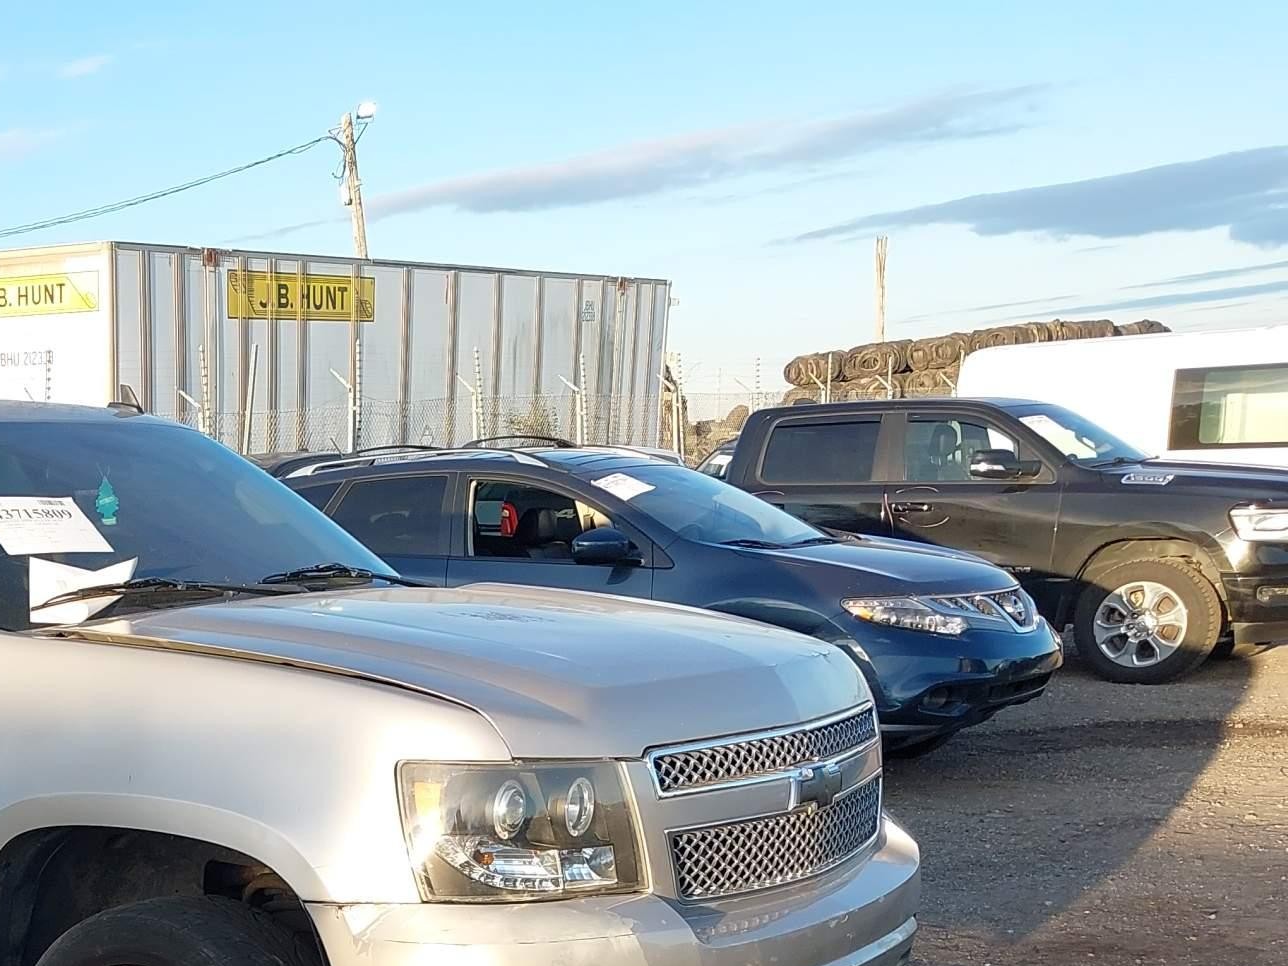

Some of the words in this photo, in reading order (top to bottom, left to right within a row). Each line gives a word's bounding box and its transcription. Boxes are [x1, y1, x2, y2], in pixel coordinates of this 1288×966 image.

[18, 283, 66, 306] HUNT
[259, 284, 294, 309] J.B.
[301, 284, 348, 310] HUNT
